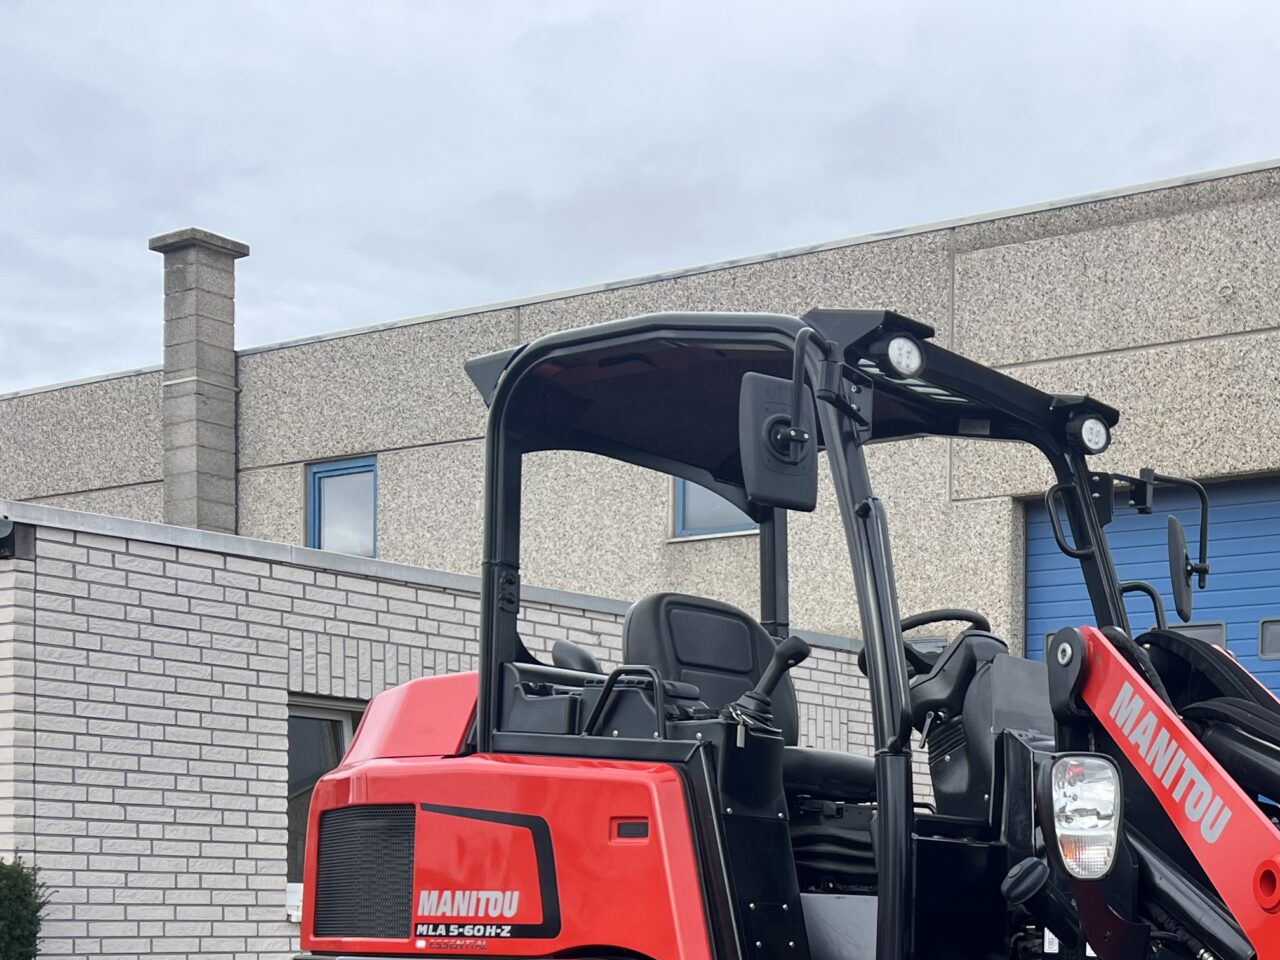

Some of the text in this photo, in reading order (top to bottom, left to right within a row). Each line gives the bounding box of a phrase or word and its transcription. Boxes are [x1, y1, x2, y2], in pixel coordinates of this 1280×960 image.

[1109, 680, 1232, 844] MANITOU
[417, 890, 520, 918] MANITOU
[416, 924, 446, 936] MLA
